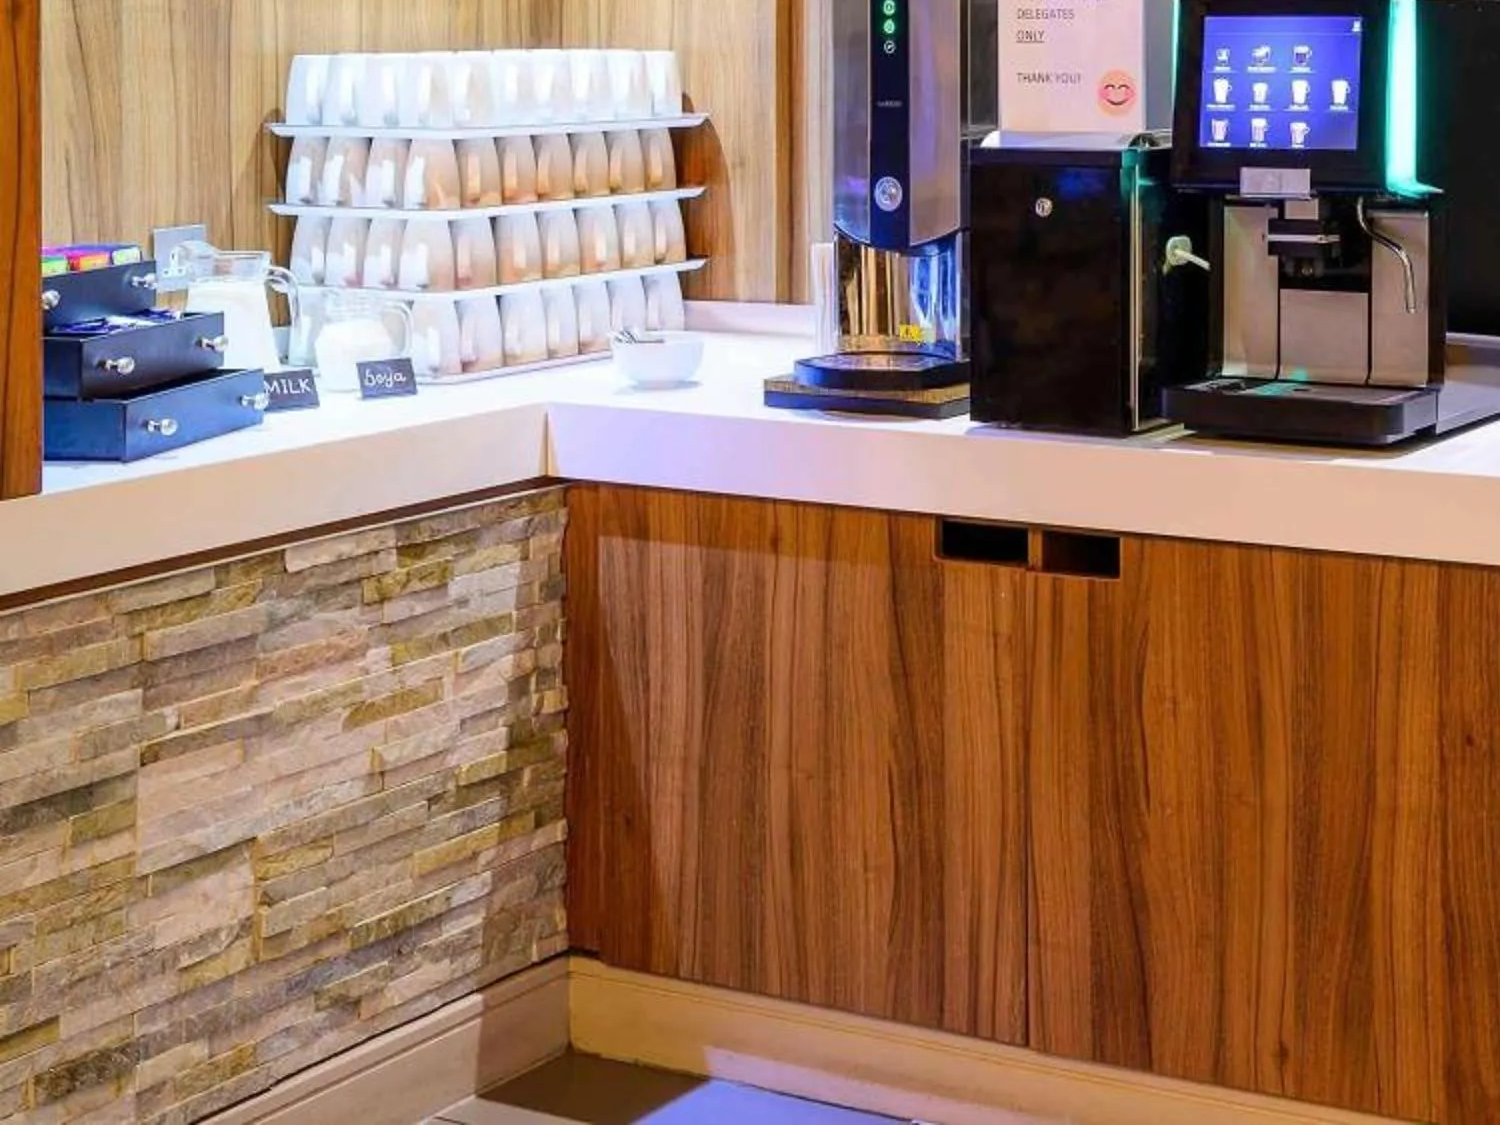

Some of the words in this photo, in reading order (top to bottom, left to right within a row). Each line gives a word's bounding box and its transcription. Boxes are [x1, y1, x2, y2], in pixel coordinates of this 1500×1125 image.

[1017, 7, 1075, 20] DELEGATES
[1016, 29, 1045, 43] ONLY
[1017, 72, 1051, 85] THANK
[264, 378, 313, 396] MILK
